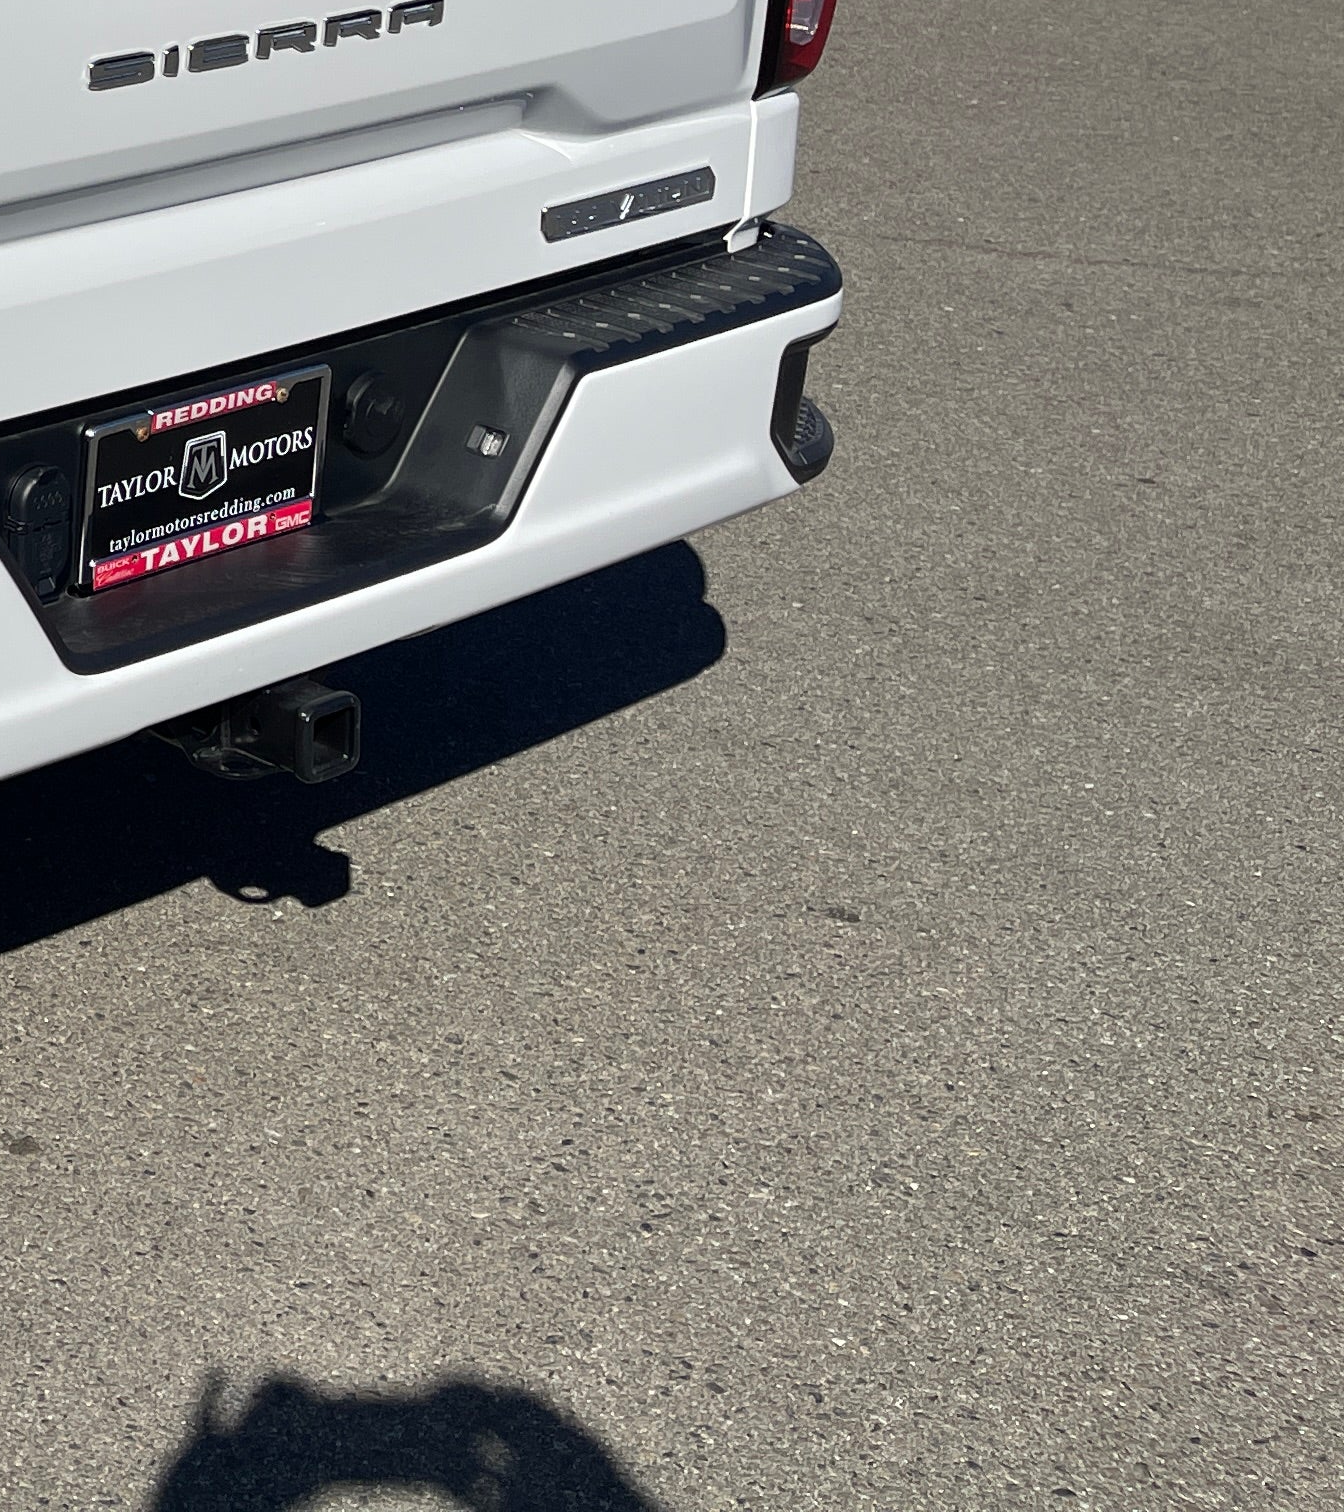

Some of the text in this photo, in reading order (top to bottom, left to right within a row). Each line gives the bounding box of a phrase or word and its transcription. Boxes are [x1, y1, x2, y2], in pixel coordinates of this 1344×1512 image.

[155, 384, 273, 430] REDDING
[97, 466, 177, 508] TAYLOR
[229, 426, 313, 470] MOTORS
[97, 510, 310, 574] BUICK TAYLOR GMC
[109, 487, 296, 553] taylormotorsredding.com
